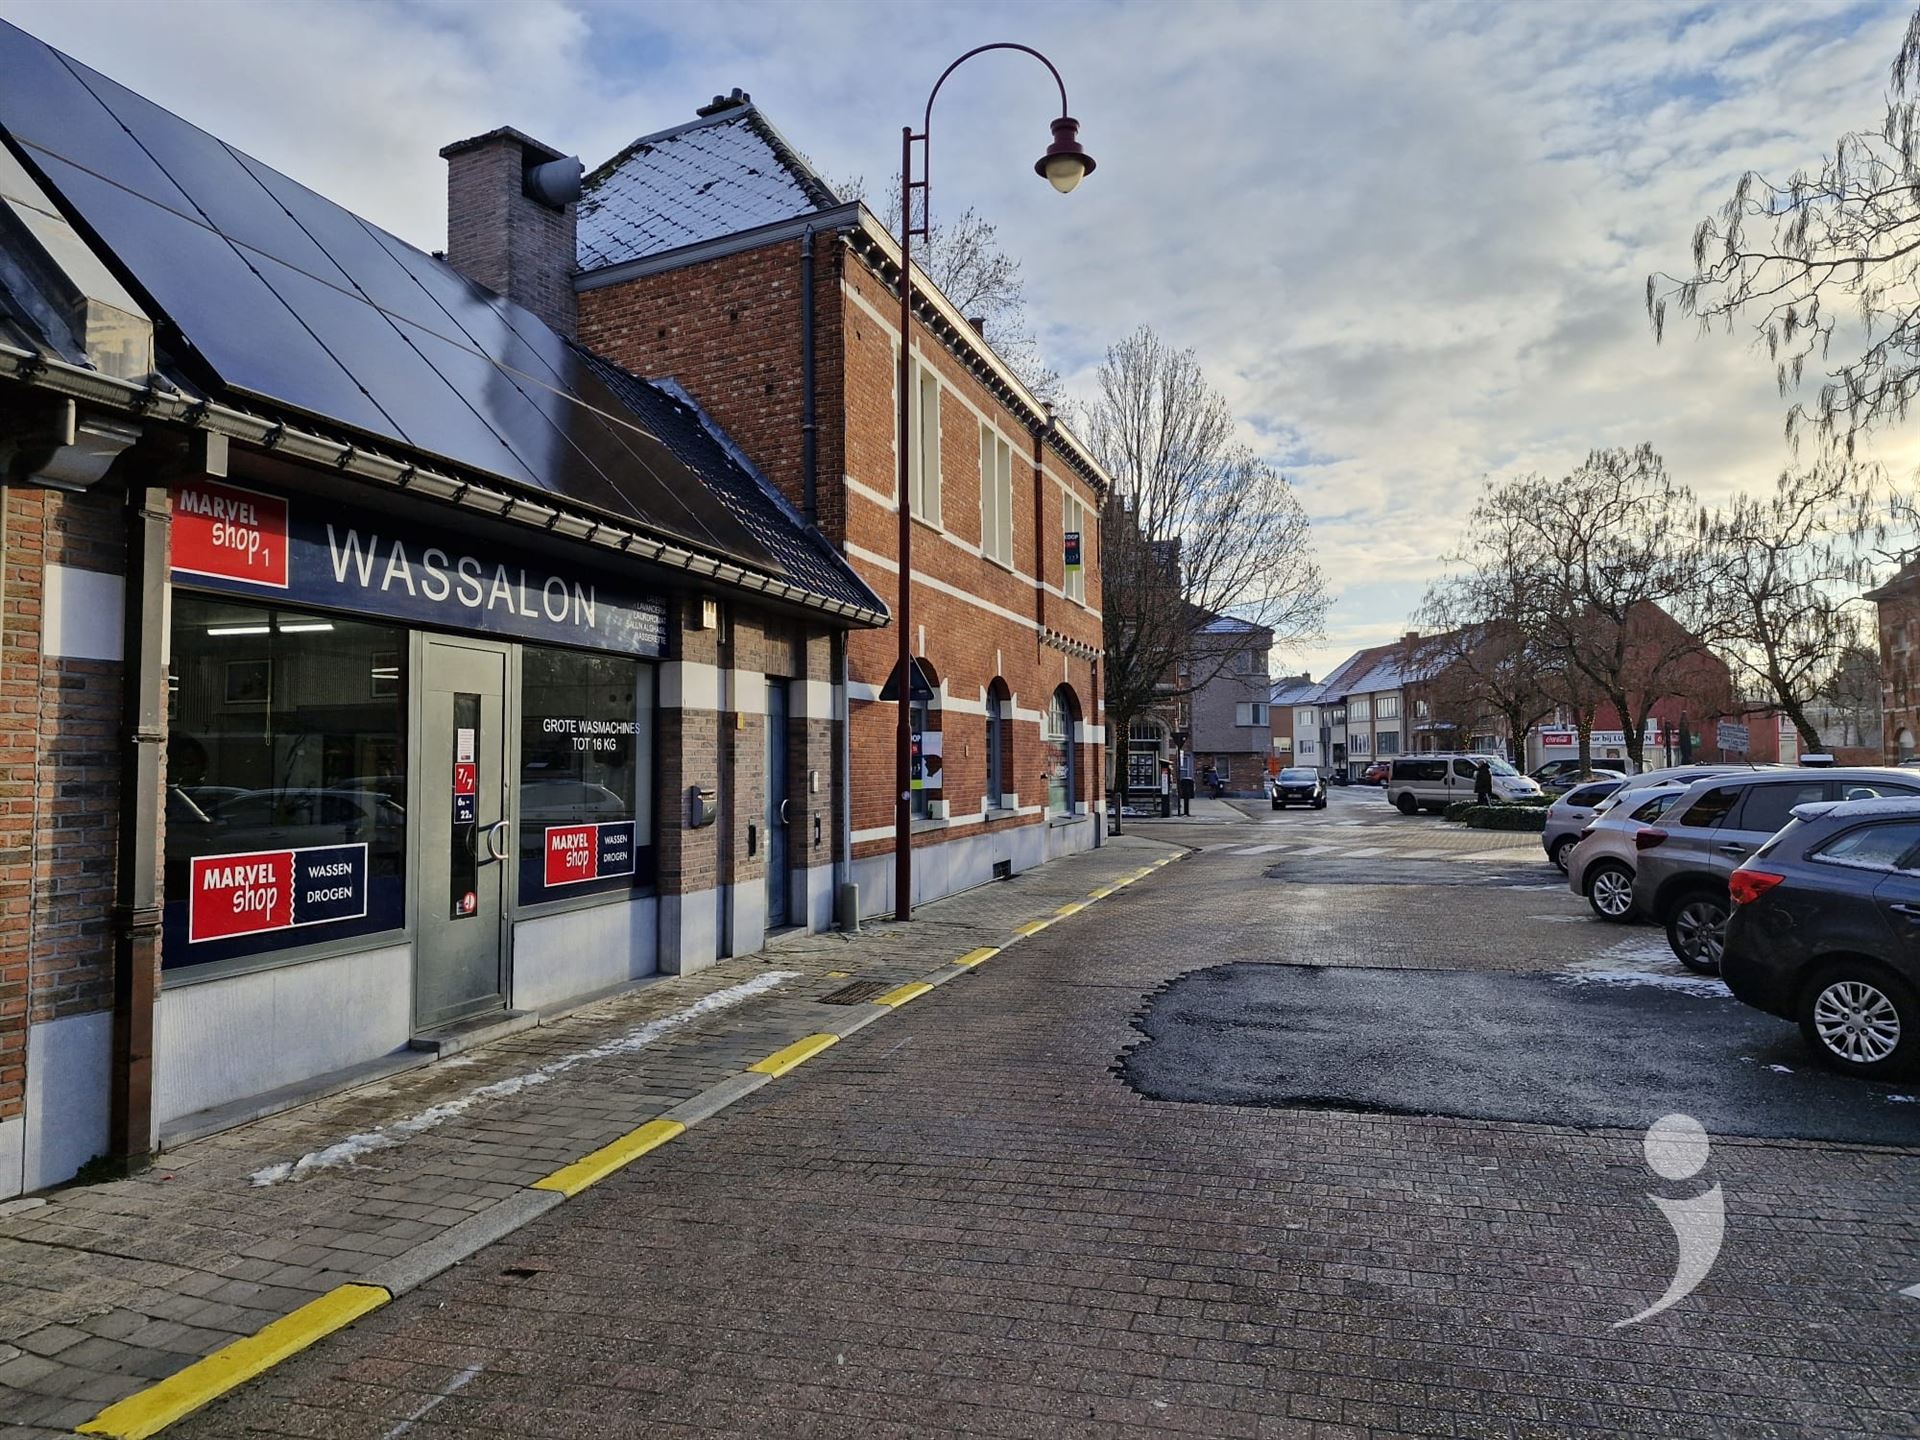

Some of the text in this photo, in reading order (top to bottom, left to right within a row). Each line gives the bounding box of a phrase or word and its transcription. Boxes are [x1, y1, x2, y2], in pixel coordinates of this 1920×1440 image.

[180, 489, 258, 526] MARVEL
[212, 515, 269, 567] shop 1
[326, 523, 595, 628] WASSALON
[543, 718, 640, 735] GROTE WASMACHINES
[572, 737, 616, 751] TOT 16 KG
[458, 768, 473, 790] 7/7
[552, 833, 588, 851] MARVEL
[604, 834, 628, 845] WASSEN
[566, 845, 589, 874] shop
[603, 851, 628, 863] DROGEN
[203, 863, 276, 890] MARVEL
[308, 863, 352, 879] WASSEN
[233, 880, 278, 921] shop
[307, 886, 352, 904] DROGEN
